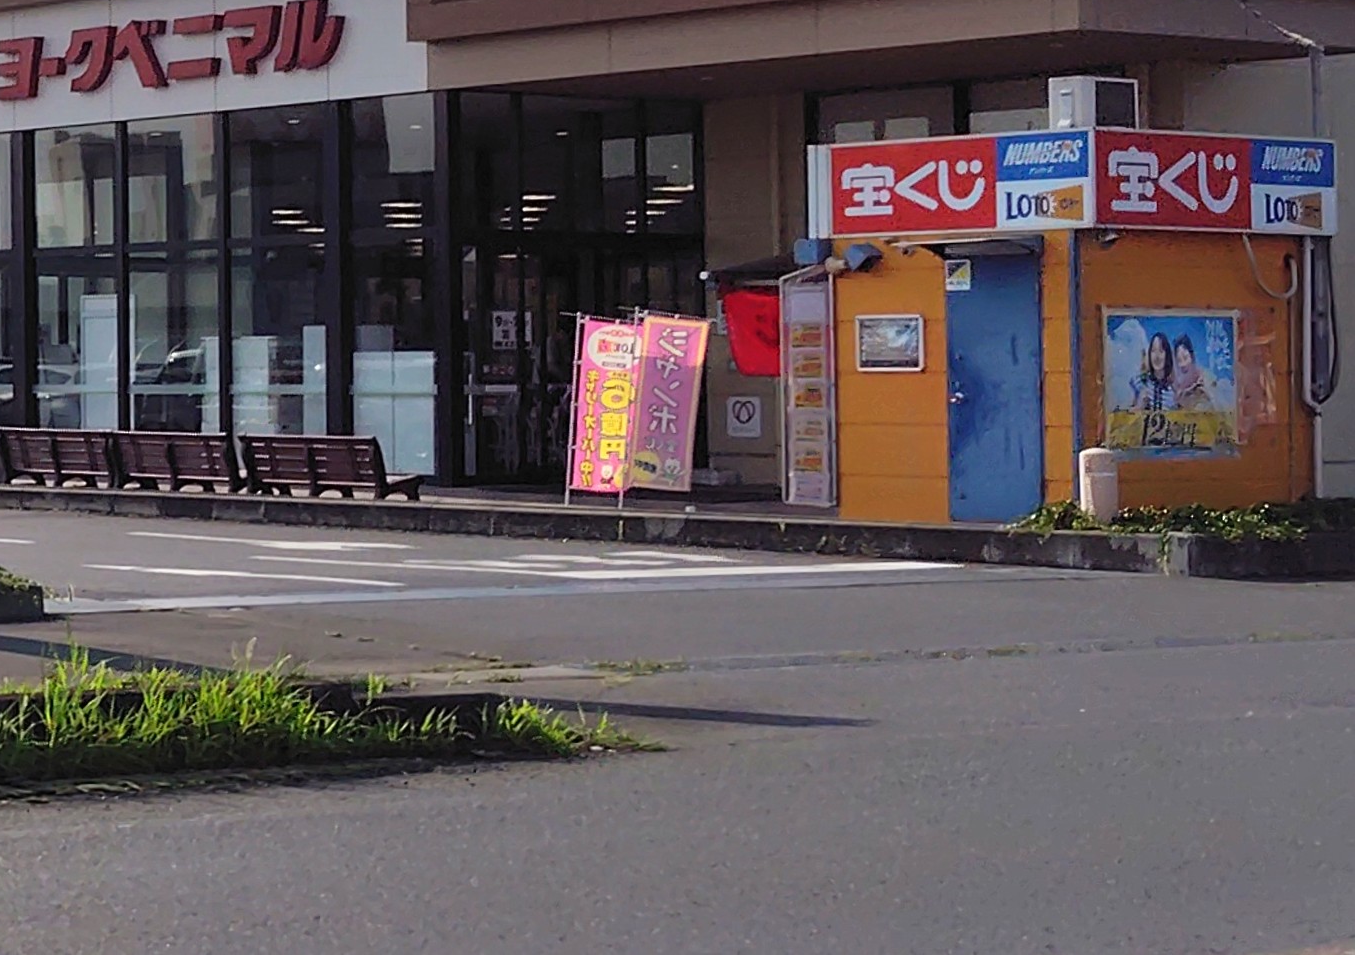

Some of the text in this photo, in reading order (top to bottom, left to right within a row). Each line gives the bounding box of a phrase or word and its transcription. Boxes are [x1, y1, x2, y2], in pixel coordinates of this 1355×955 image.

[1003, 139, 1084, 166] NUMBERS
[1261, 146, 1324, 173] NUMBERS
[841, 159, 986, 217] 宝くじ
[1108, 145, 1239, 214] 宝くじ
[1005, 192, 1050, 221] LOTO
[1265, 193, 1299, 223] LOTO
